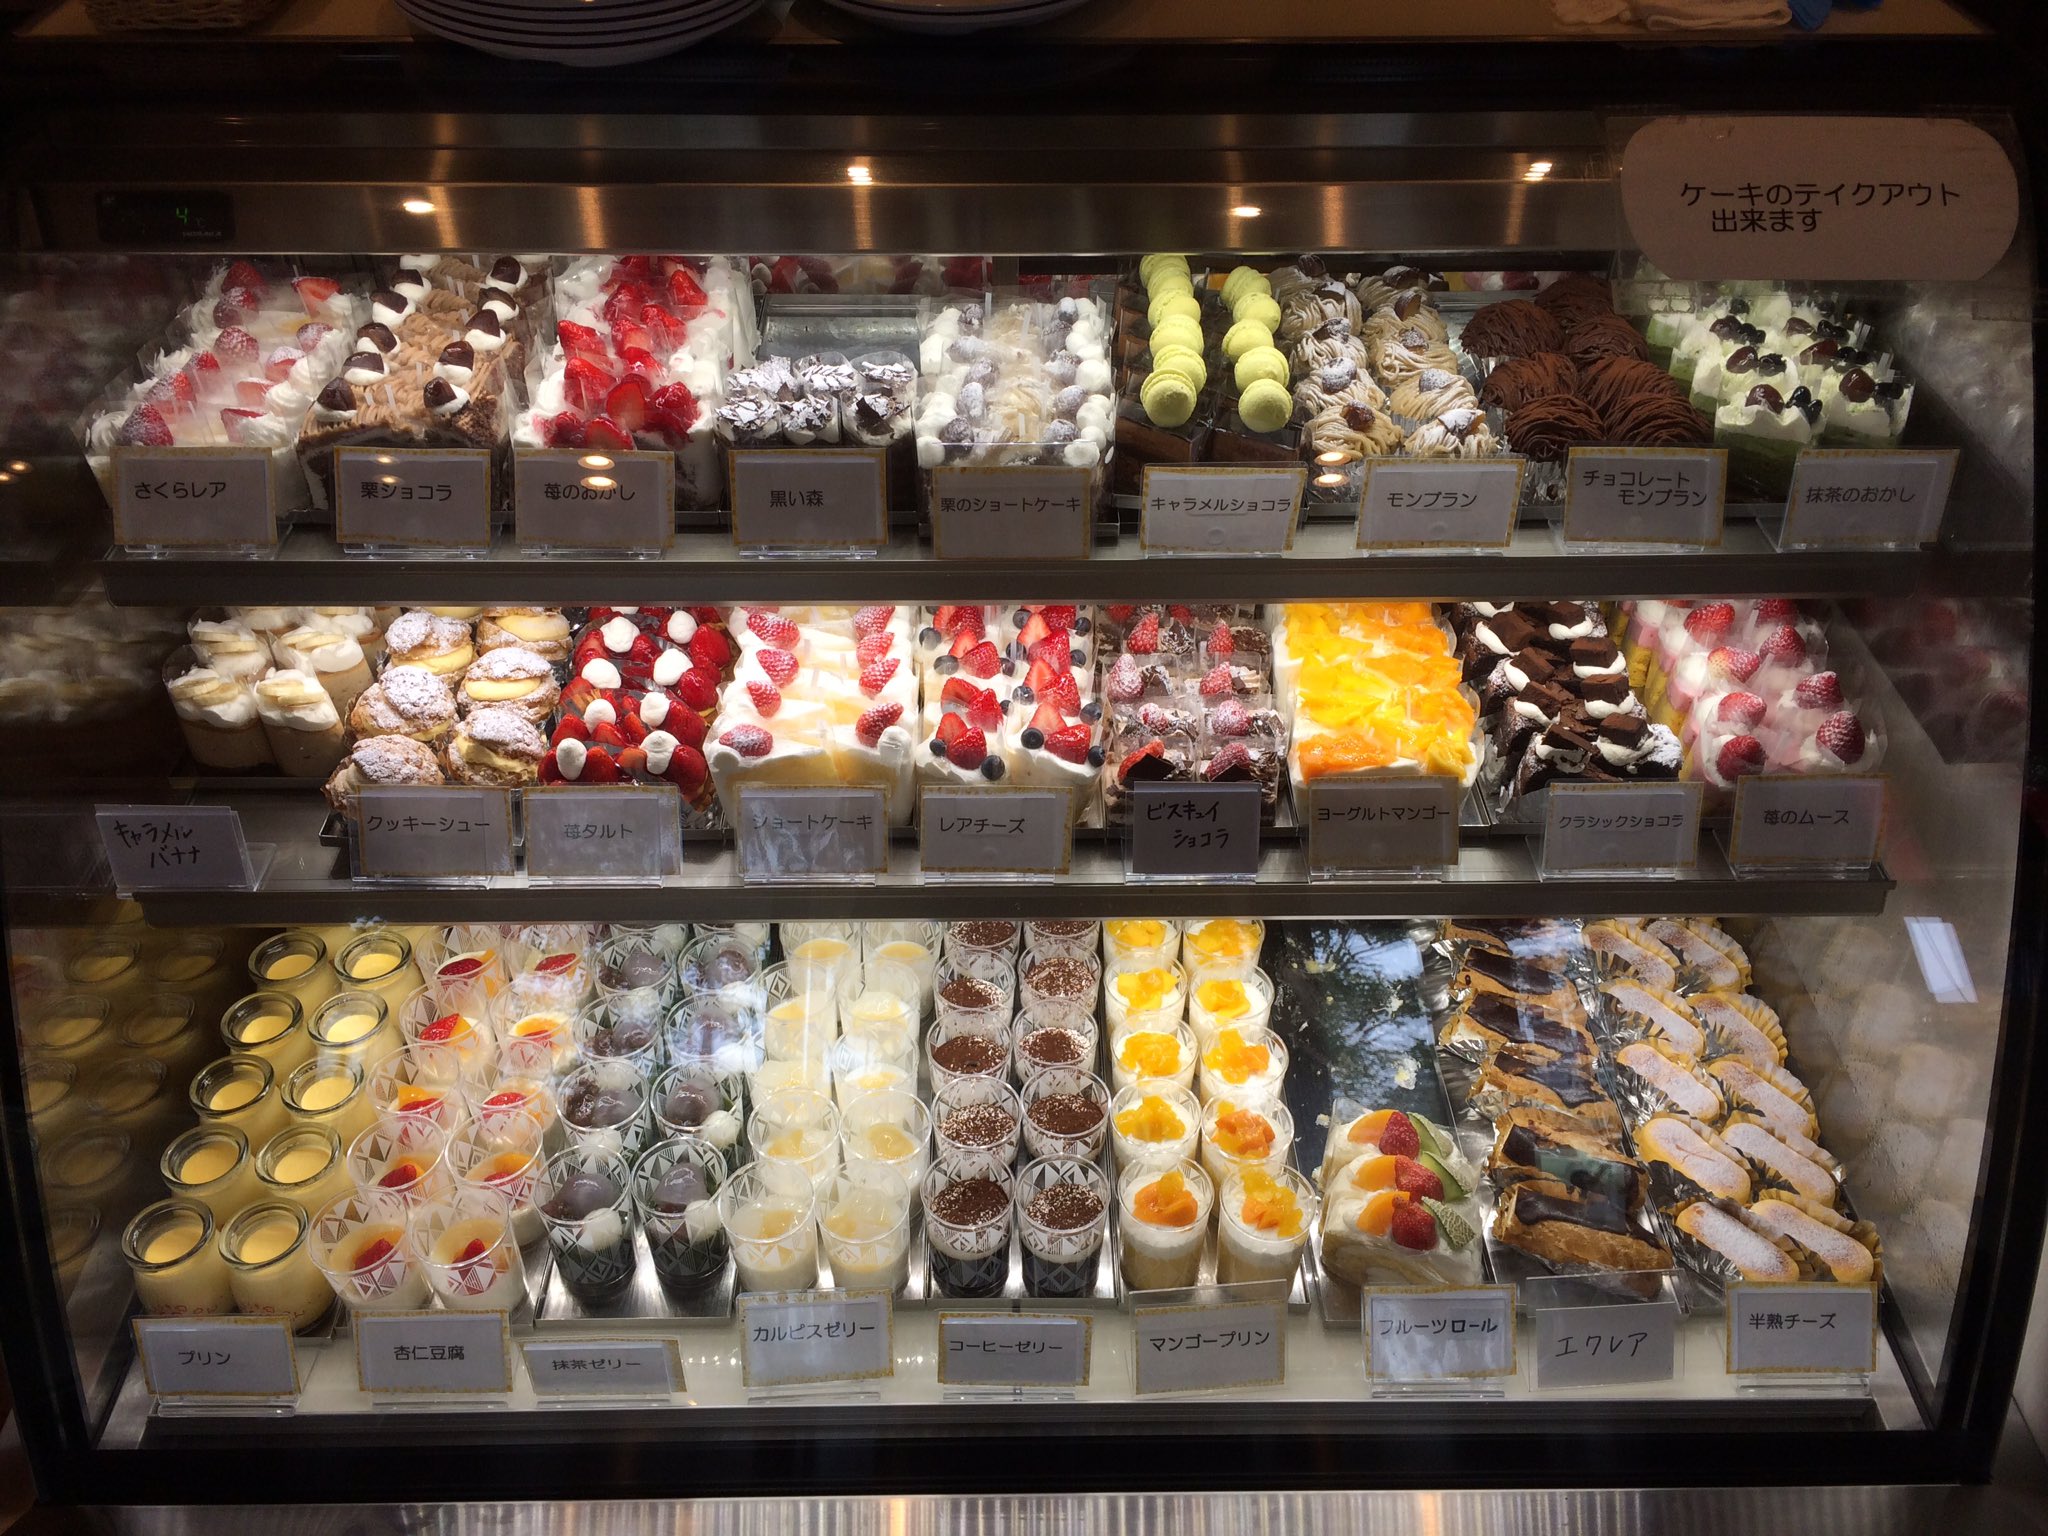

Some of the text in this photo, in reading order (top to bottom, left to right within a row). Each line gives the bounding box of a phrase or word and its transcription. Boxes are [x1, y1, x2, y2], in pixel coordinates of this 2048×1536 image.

[1680, 181, 1961, 207] ケーキのテイクアウト
[176, 207, 189, 224] 4
[1711, 207, 1824, 233] 出来ます
[1583, 470, 1690, 488] チョコレート
[133, 481, 227, 499] さくらレア
[360, 481, 453, 502] 栗ショコラ
[769, 489, 825, 508] 黒い森
[1386, 491, 1478, 508] モンブラン
[1618, 488, 1708, 507] モンブラン
[1805, 486, 1917, 504] 抹茶のおかし
[940, 497, 1081, 514] 栗のショートケーキ
[1150, 495, 1292, 514] キャラメルショコラ
[1147, 800, 1220, 822] ビスキュイ
[1317, 805, 1451, 822] ヨーグルトマンゴー
[1763, 809, 1850, 826] 苺のムース
[366, 815, 491, 833] クッキーシュー
[564, 822, 634, 841] 苺タルト
[752, 814, 873, 831] ショートケーキ
[939, 816, 1025, 835] レアチーズ
[1558, 814, 1684, 830] クラシックショコラ
[1173, 828, 1230, 849] ショコラ
[150, 845, 201, 868] バナナ
[1378, 1315, 1498, 1335] フルーツロール
[1749, 1312, 1837, 1331] 半熟チーズ
[753, 1321, 875, 1342] カルピスゼリー
[949, 1340, 1063, 1355] コーヒーゼリー
[1149, 1331, 1270, 1352] マンゴープリン
[1554, 1333, 1649, 1358] エクレア
[178, 1350, 231, 1366] プリン
[393, 1345, 465, 1362] 杏仁豆腐
[551, 1359, 642, 1372] 抹茶ゼリー
